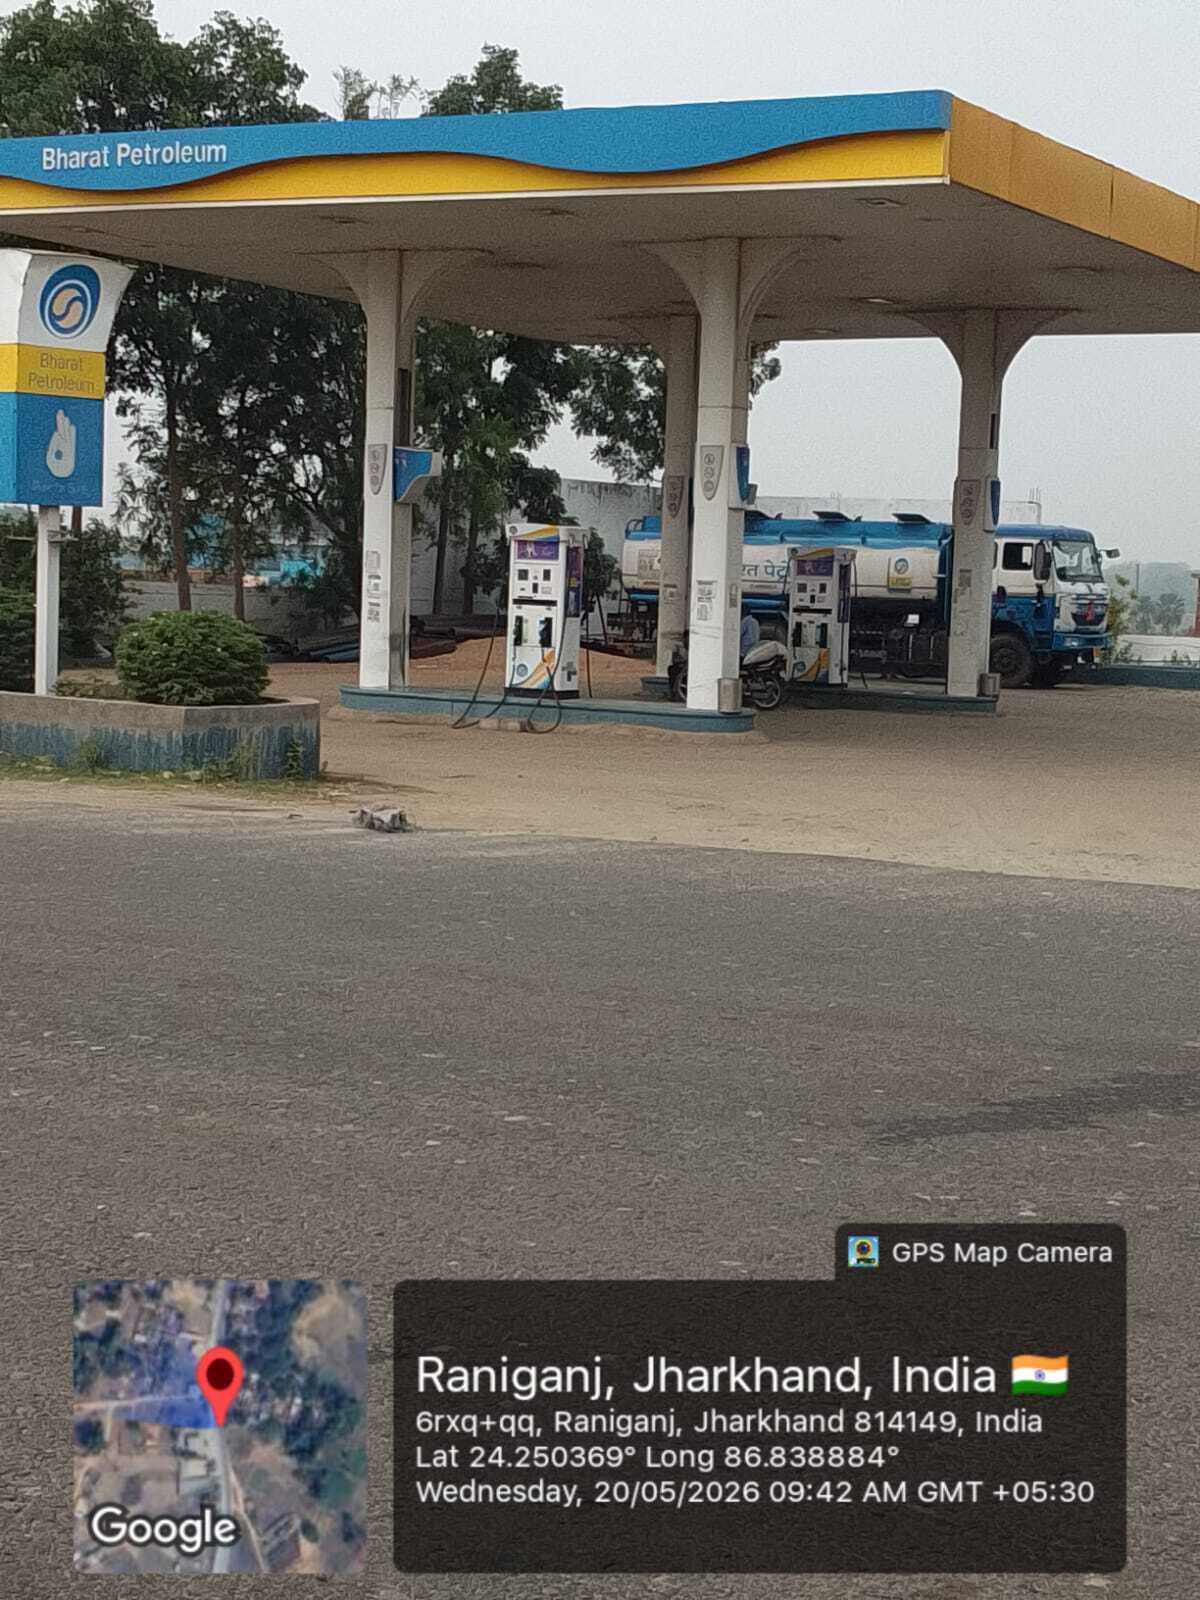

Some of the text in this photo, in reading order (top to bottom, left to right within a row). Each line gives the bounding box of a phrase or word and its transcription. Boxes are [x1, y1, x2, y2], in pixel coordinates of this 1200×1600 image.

[42, 141, 227, 170] Bharat Petroleum
[40, 352, 83, 370] Bharat
[28, 372, 97, 393] Petroleum
